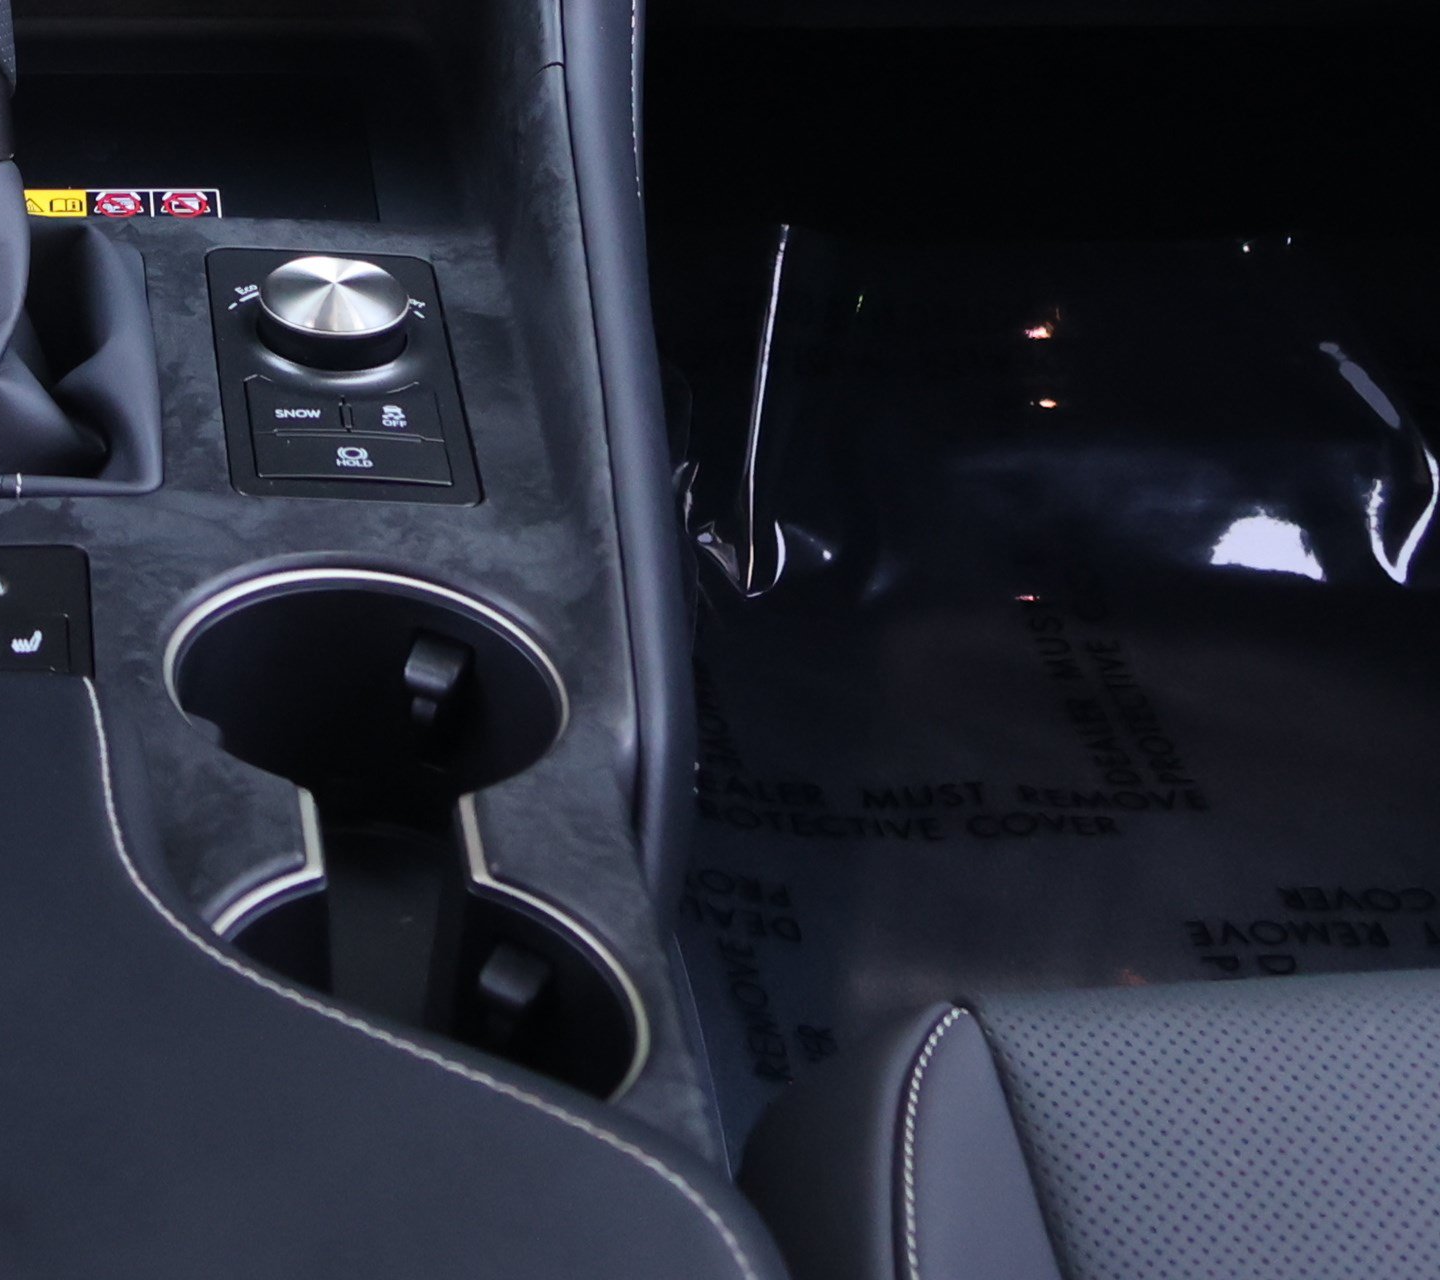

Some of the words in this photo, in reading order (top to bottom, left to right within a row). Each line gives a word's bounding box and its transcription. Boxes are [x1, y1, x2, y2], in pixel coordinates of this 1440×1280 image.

[275, 408, 321, 419] SNOW
[382, 419, 407, 428] OFF
[336, 459, 374, 468] HOLD
[862, 780, 985, 810] MUST
[1017, 783, 1211, 812] REMOVE
[967, 810, 1123, 838] COVER
[1275, 885, 1438, 918] COVER
[1185, 919, 1393, 951] REMOVE
